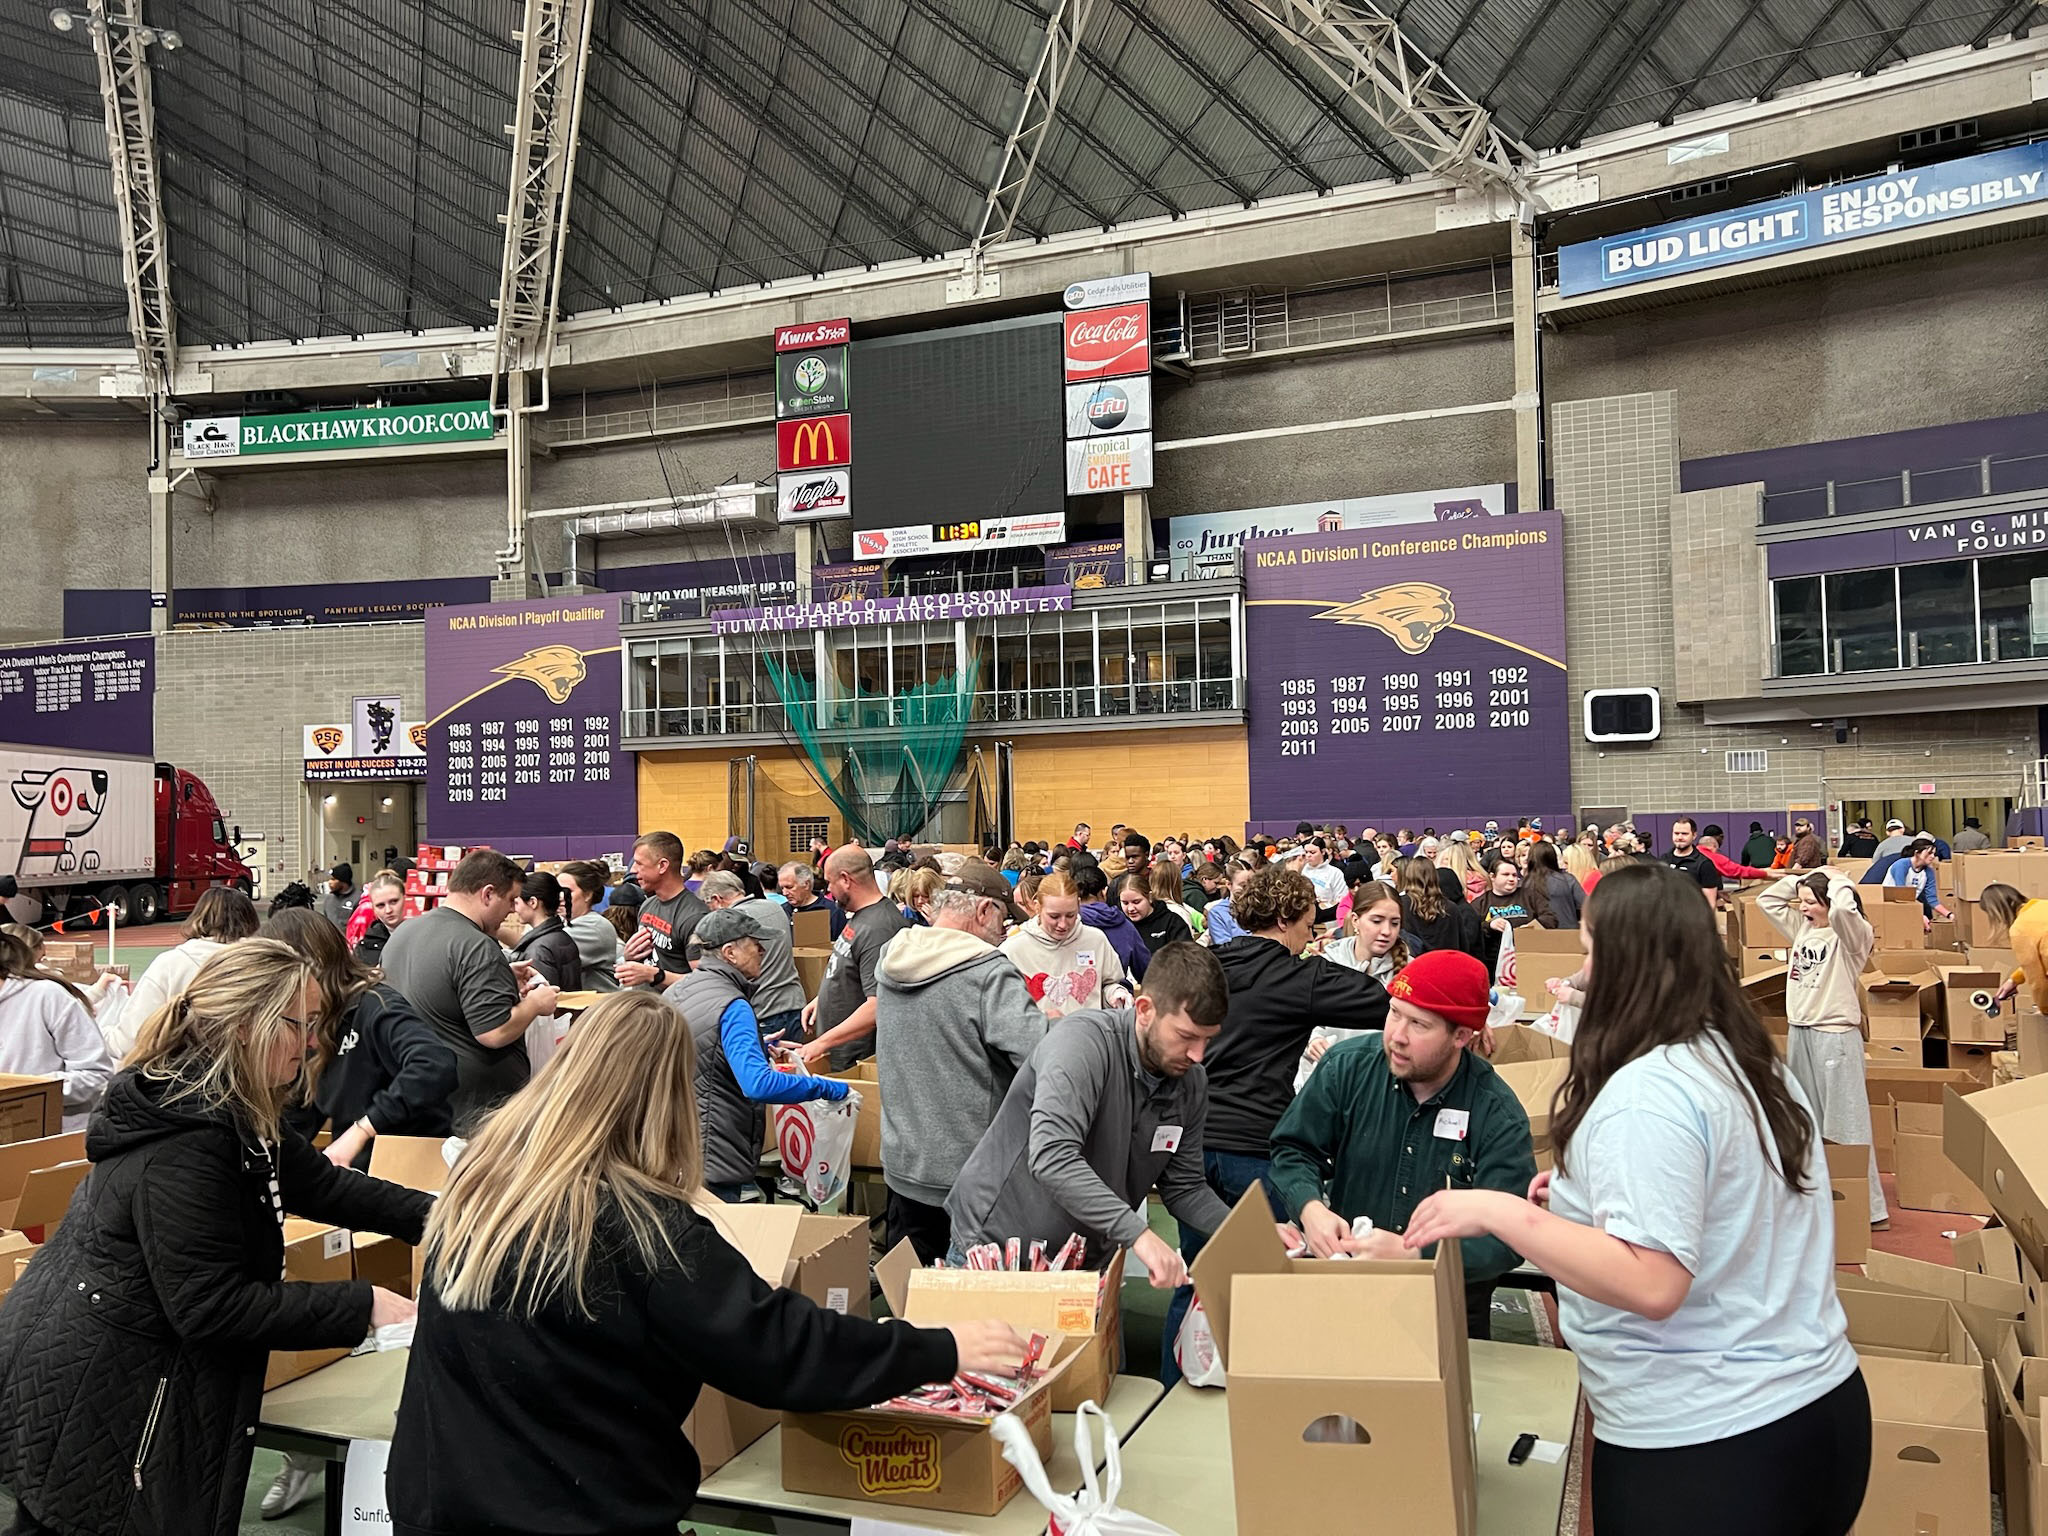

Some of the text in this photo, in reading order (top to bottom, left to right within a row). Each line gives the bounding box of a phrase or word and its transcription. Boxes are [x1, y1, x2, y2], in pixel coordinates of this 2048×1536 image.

[1822, 176, 1918, 216] ENJOY
[1824, 171, 2042, 236] RESPONSIBLY
[1609, 208, 1797, 273] BUD LIGHT
[1088, 288, 1105, 296] Cedar
[1122, 282, 1146, 290] Utilities
[1088, 396, 1126, 418] cfu
[243, 411, 490, 445] BLACKHAWKROOF.COM
[1087, 438, 1130, 454] tropical
[1088, 452, 1130, 466] SMOOTHIE
[1088, 464, 1131, 489] CAFE
[938, 522, 979, 540] 11:39
[1908, 524, 1955, 542] VAN
[1970, 520, 1996, 534] G.
[1958, 529, 2046, 552] FOUND
[892, 546, 930, 554] ASSOCIATION
[1098, 543, 1122, 552] SHOP
[1177, 540, 1194, 549] GO
[1256, 529, 1548, 568] NCAA Division I Conference Champions
[1207, 553, 1232, 562] THAN
[858, 564, 880, 572] SHOP
[672, 590, 697, 600] YOU
[760, 582, 776, 594] UP
[779, 580, 796, 592] TO
[325, 602, 445, 615] PANTHER LEGACY SOCIETY
[764, 599, 852, 618] RICHARD
[896, 588, 1012, 610] JACOBSON
[178, 610, 226, 619] PANTHERS
[240, 610, 256, 618] THE
[258, 608, 304, 618] SPOTLIGHT
[450, 608, 605, 630] NCAA Division I Playoff Qualifier
[717, 597, 1064, 634] HUMAN PERFORMANCE COMPLEX
[12, 656, 34, 668] Division
[39, 654, 56, 666] Men's
[57, 652, 90, 664] Conference
[92, 650, 126, 661] Champions
[90, 662, 111, 672] Outdoor
[112, 660, 126, 670] Track
[132, 659, 146, 668] Field
[34, 668, 50, 676] Indoor
[51, 666, 64, 674] Track
[70, 664, 84, 672] Field
[1280, 667, 1528, 695] 1985 1987 1990 1991 1992
[1281, 688, 1529, 715] 1993 1994 1995 1996 2001
[448, 716, 609, 737] 1985 1987 1990 1991 1992
[1281, 710, 1529, 736] 2003 2005 2007 2008 2010
[316, 732, 341, 743] PSC
[448, 734, 609, 753] 1993 1994 1995 1996 2001
[1281, 740, 1316, 756] 2011
[306, 758, 427, 770] INVEST IN OUR SUCCESS 319-273
[448, 751, 610, 769] 2003 2005 2007 2008 2010
[448, 767, 610, 786] 2011 2014 2015 2017 2018
[448, 788, 506, 801] 2019 2021
[846, 1431, 931, 1462] Country
[866, 1457, 932, 1485] Meats
